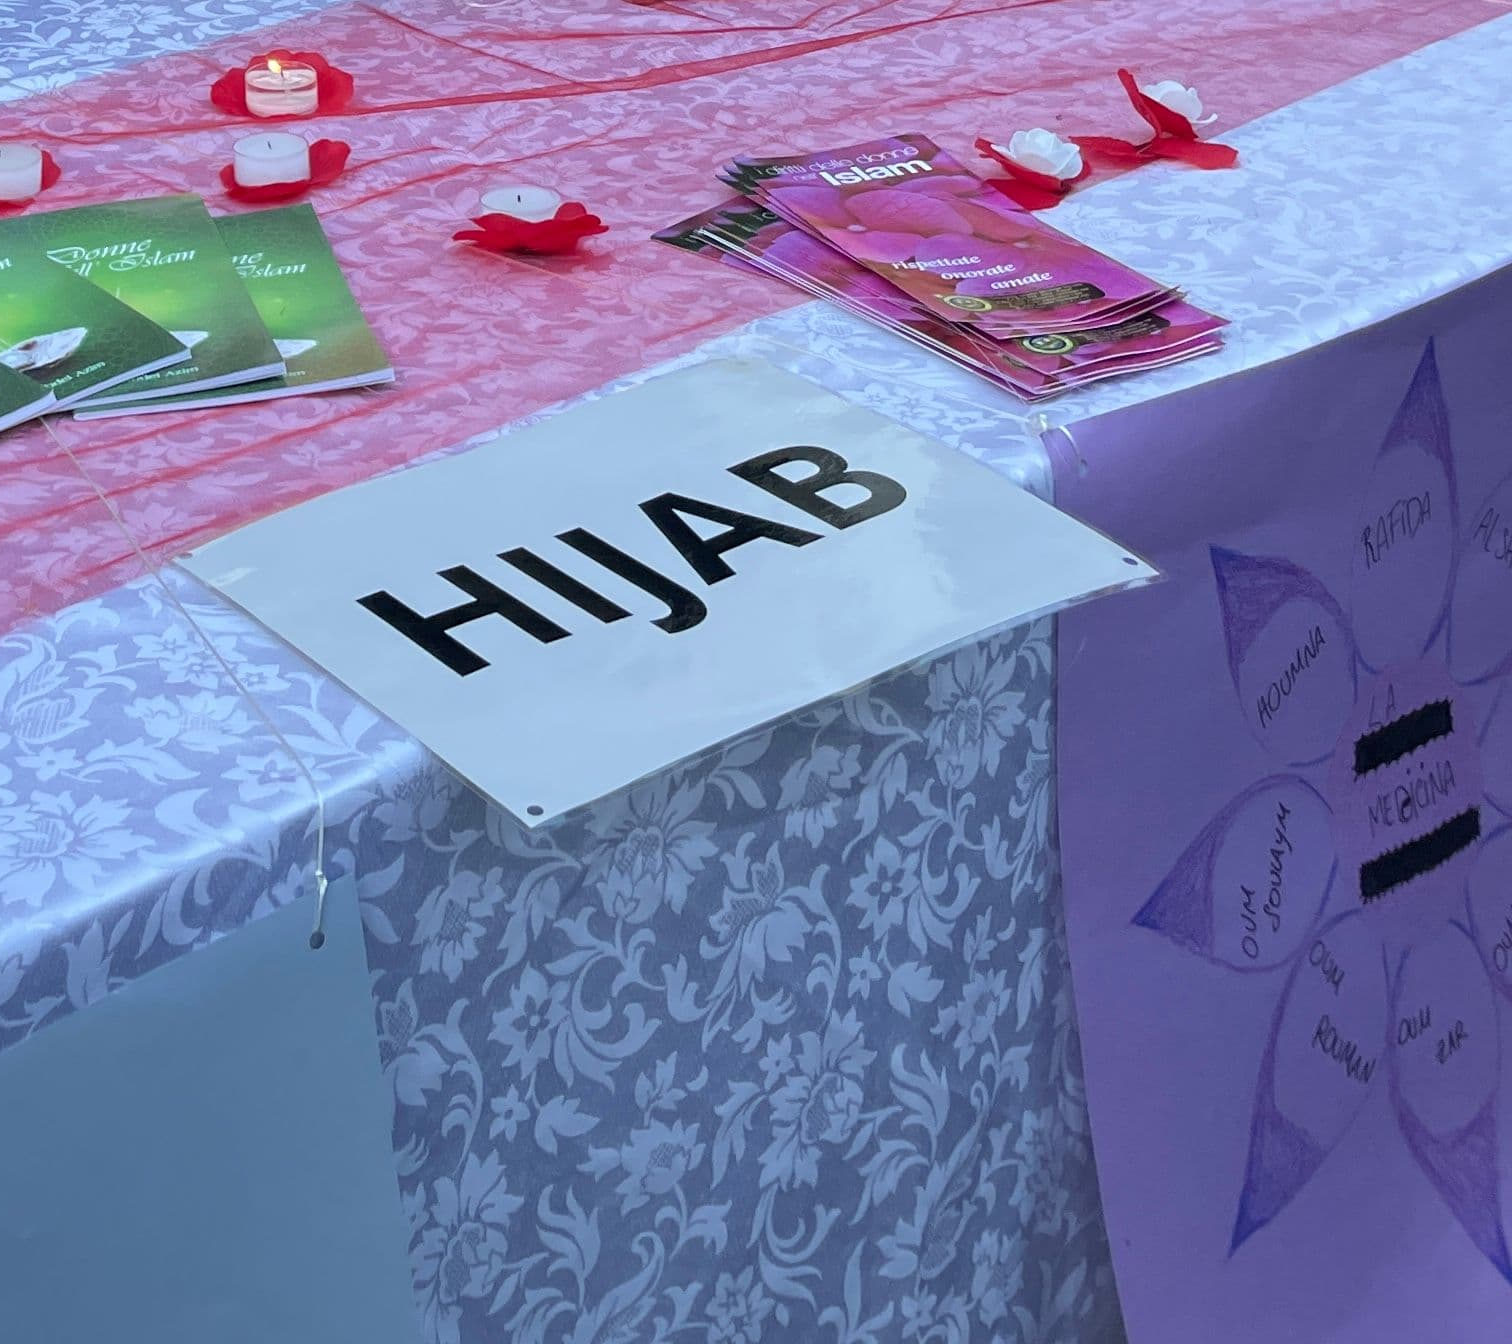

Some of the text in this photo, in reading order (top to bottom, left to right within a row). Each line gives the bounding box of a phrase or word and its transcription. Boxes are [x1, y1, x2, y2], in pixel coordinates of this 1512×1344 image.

[855, 146, 919, 164] donne
[819, 159, 933, 187] Islam
[46, 238, 152, 265] Donne
[109, 249, 196, 272] Islam
[892, 254, 982, 271] rispettate
[940, 263, 1016, 280] onorate
[990, 271, 1054, 291] amate
[355, 445, 907, 677] HIJAB
[1240, 884, 1260, 959] OUM
